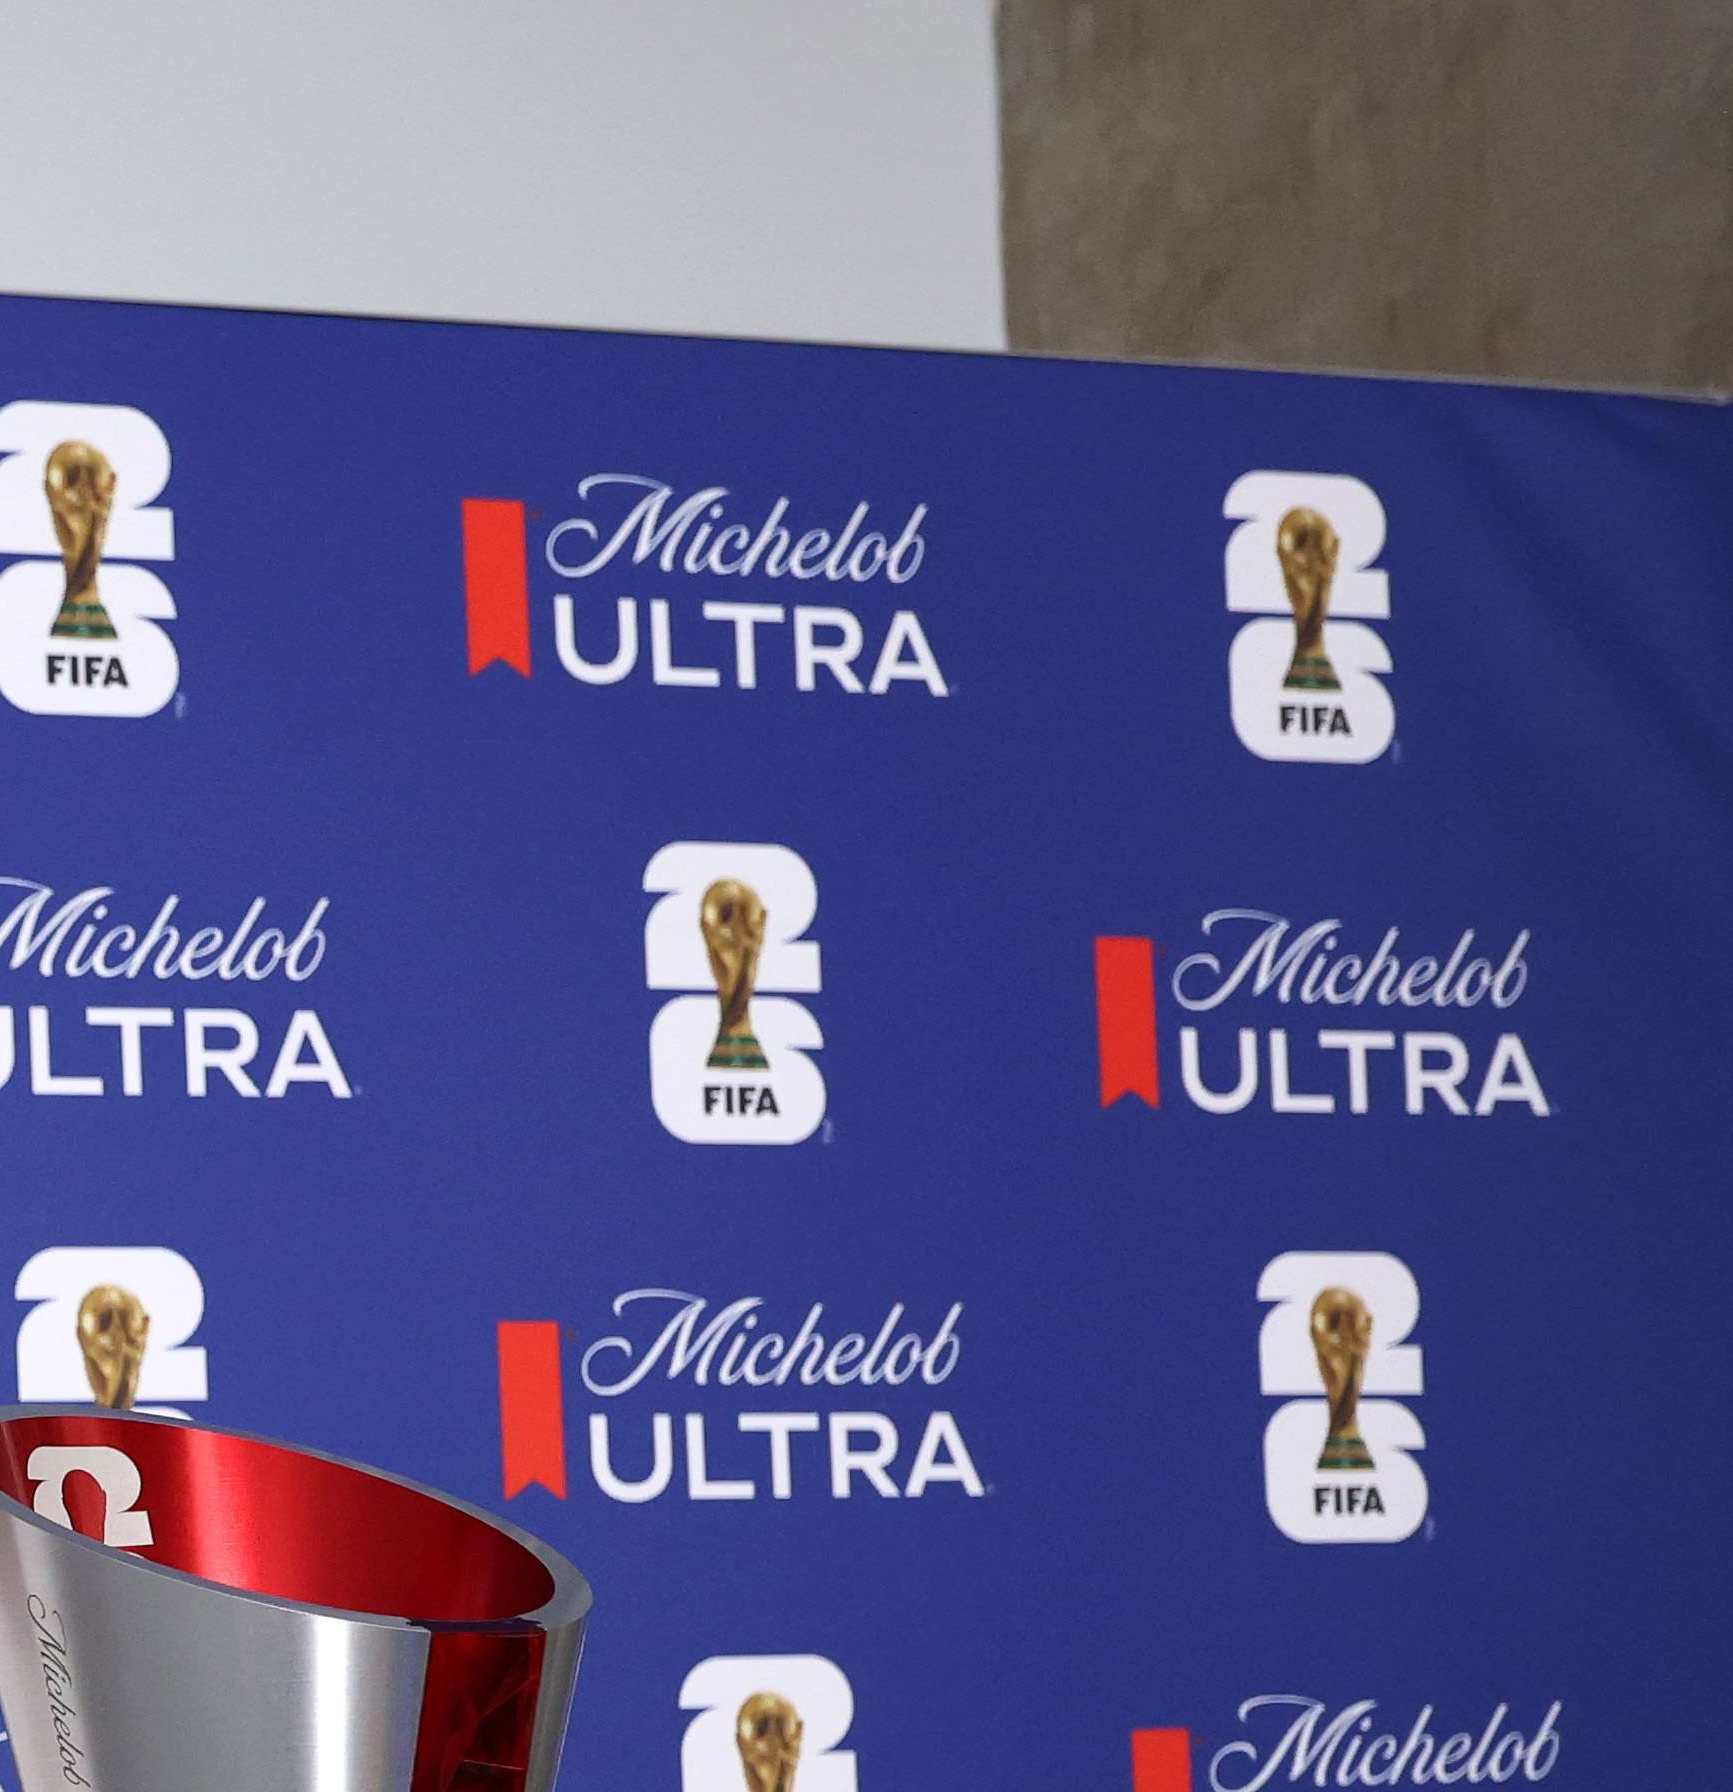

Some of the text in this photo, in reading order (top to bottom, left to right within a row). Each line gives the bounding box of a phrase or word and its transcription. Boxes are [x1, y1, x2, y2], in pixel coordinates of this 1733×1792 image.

[546, 474, 927, 583] Michelob
[47, 655, 127, 686] FIFA
[554, 594, 948, 697] ULTRA
[1281, 706, 1350, 733] FIFA
[1173, 909, 1529, 1011] Michelob
[705, 1087, 778, 1114] FIFA
[1180, 1027, 1549, 1116] ULTRA
[582, 1289, 961, 1396] Michelob
[589, 1412, 984, 1503] ULTRA
[1315, 1487, 1384, 1513] FIFA
[28, 1594, 91, 1789] Michelob
